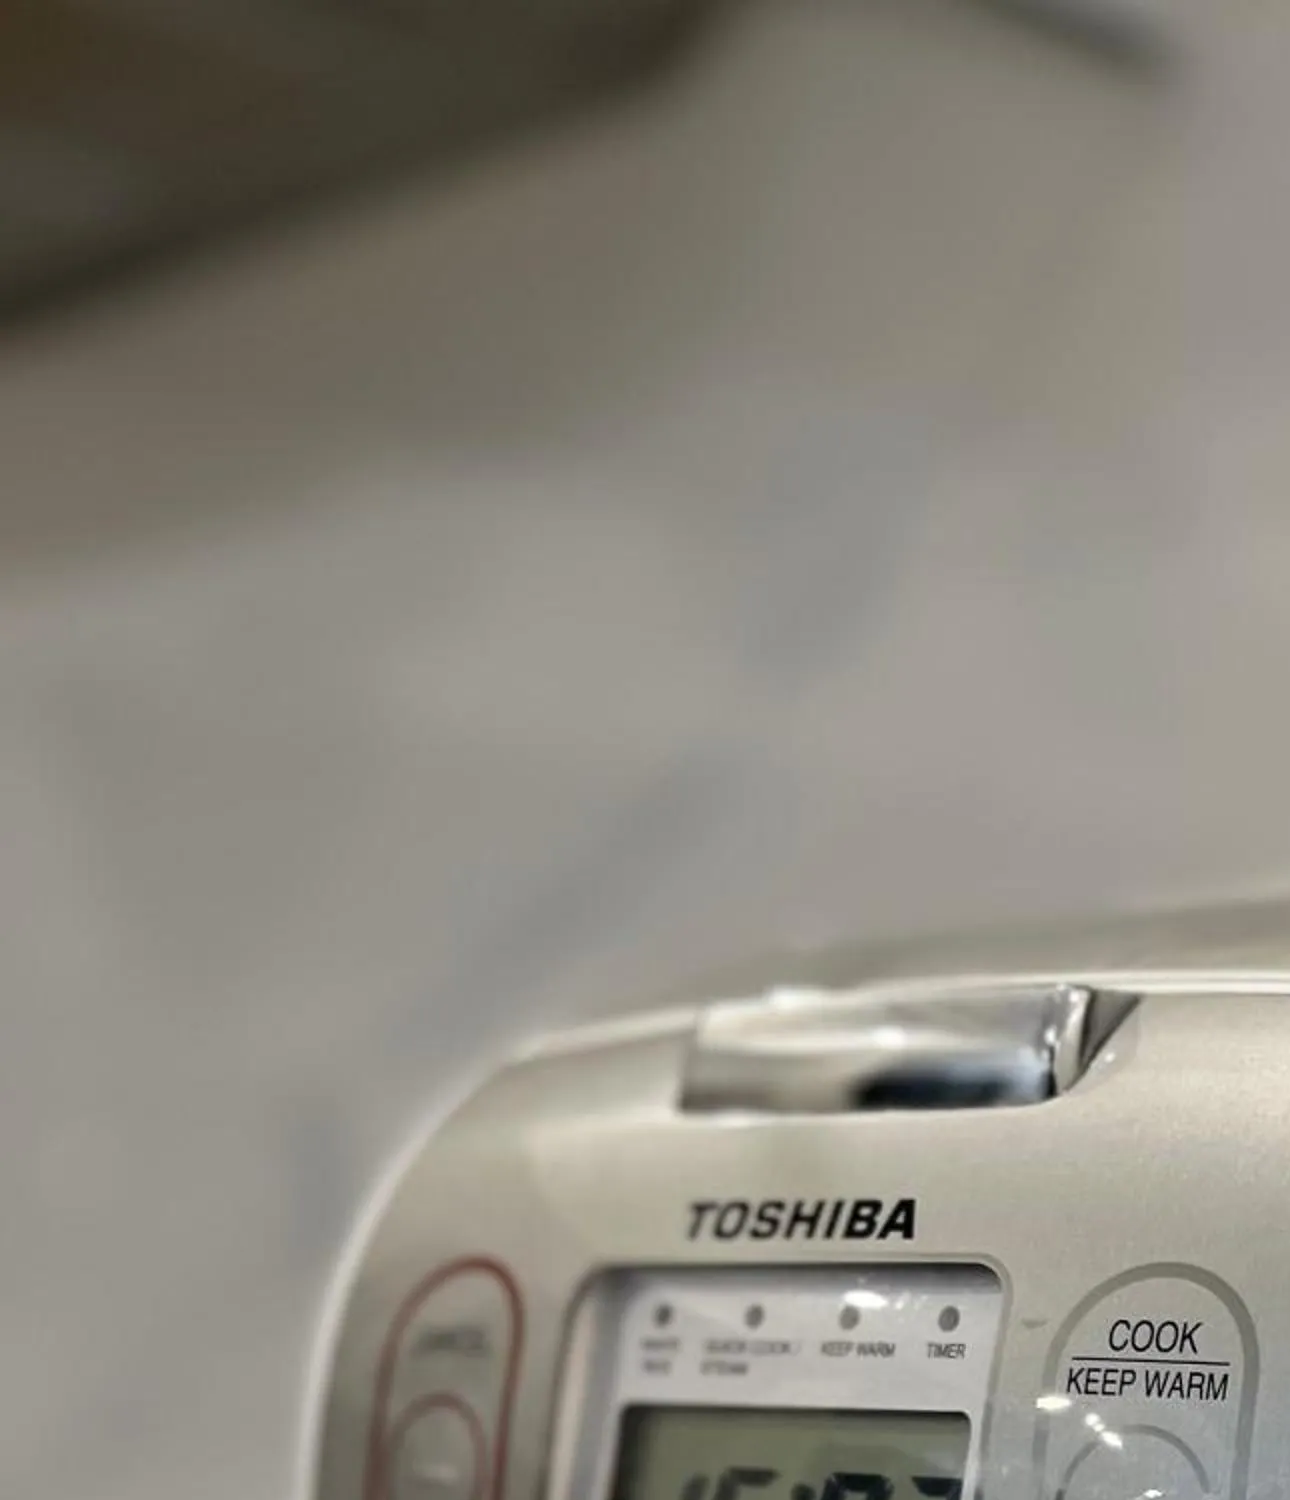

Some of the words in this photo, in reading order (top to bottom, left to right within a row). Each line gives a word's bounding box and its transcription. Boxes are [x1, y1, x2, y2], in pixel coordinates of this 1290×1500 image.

[685, 1198, 916, 1240] TOSHIBA
[927, 1342, 966, 1360] TIMER
[1108, 1319, 1203, 1354] COOK
[1066, 1367, 1137, 1396] KEEP
[1145, 1369, 1230, 1401] WARM
